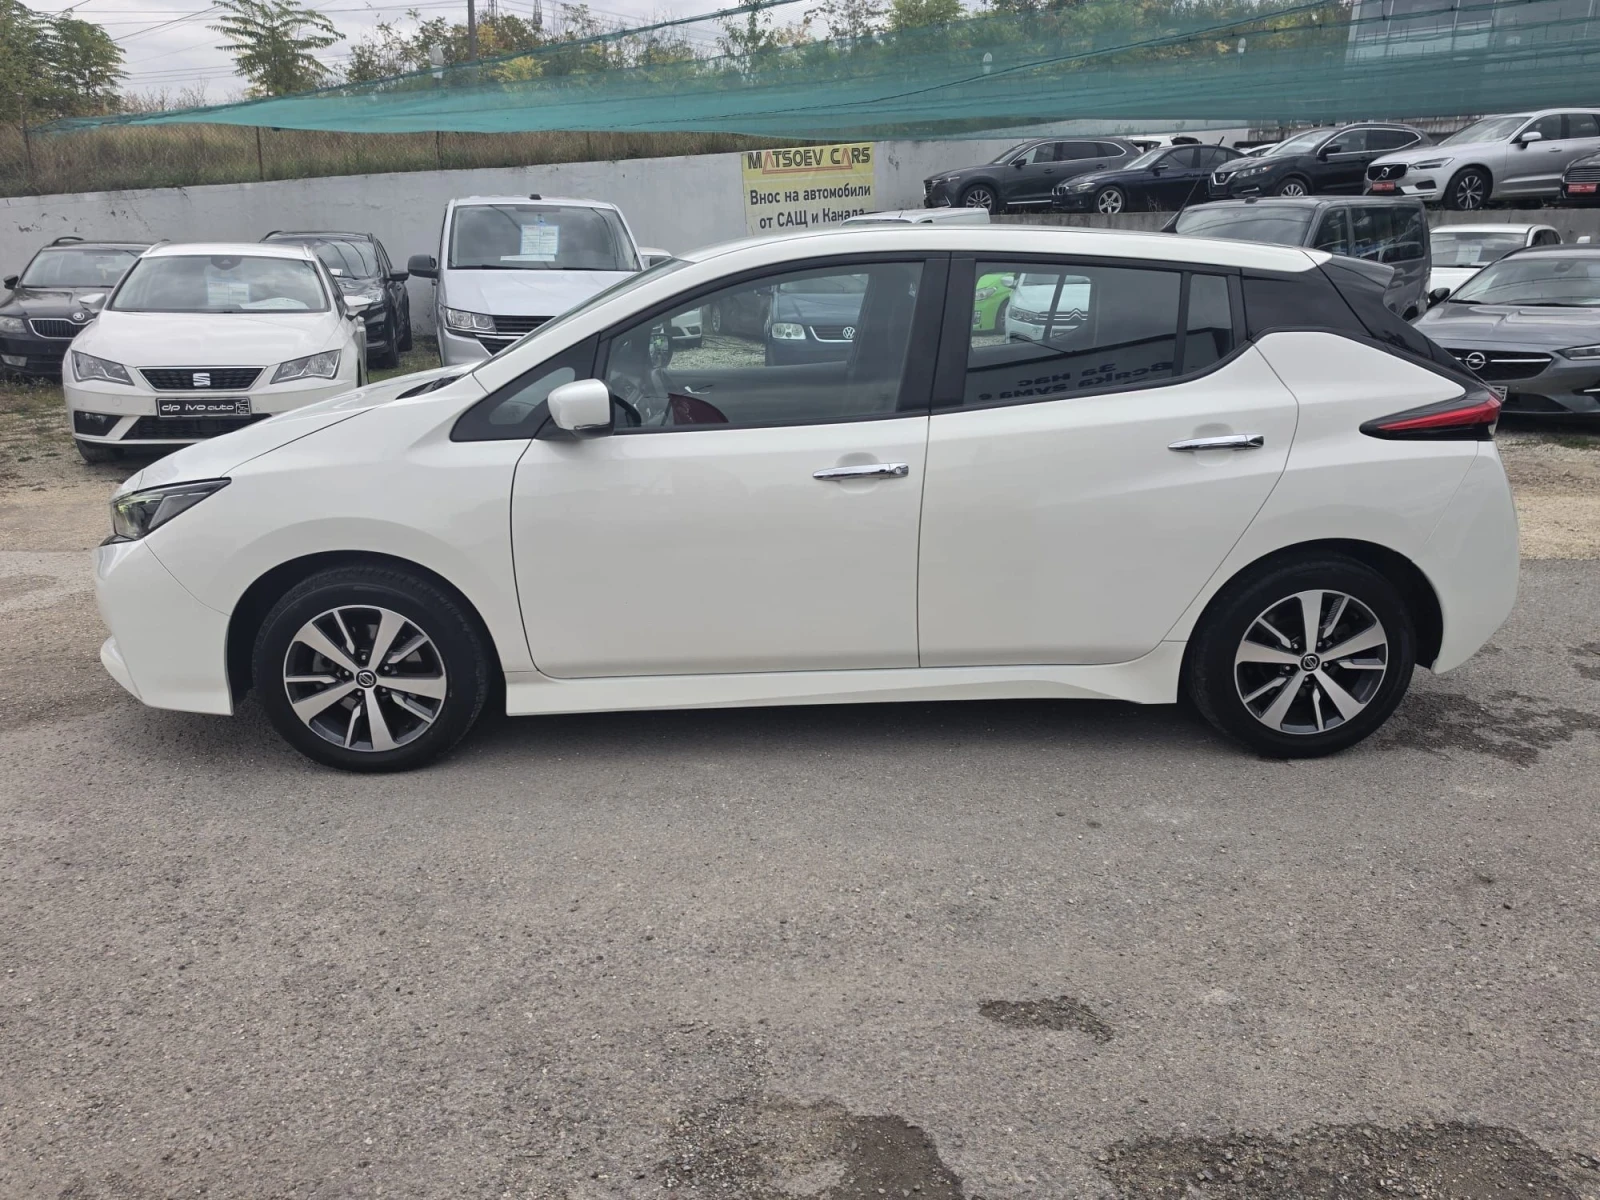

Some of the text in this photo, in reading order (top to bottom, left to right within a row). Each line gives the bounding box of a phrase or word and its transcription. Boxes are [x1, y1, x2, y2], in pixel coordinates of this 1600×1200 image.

[747, 147, 871, 170] MATSOEV CARS
[750, 182, 871, 206] Внос на автомобили
[759, 216, 774, 229] от
[777, 209, 809, 228] САЩ
[811, 212, 819, 224] и
[185, 403, 206, 411] ivo
